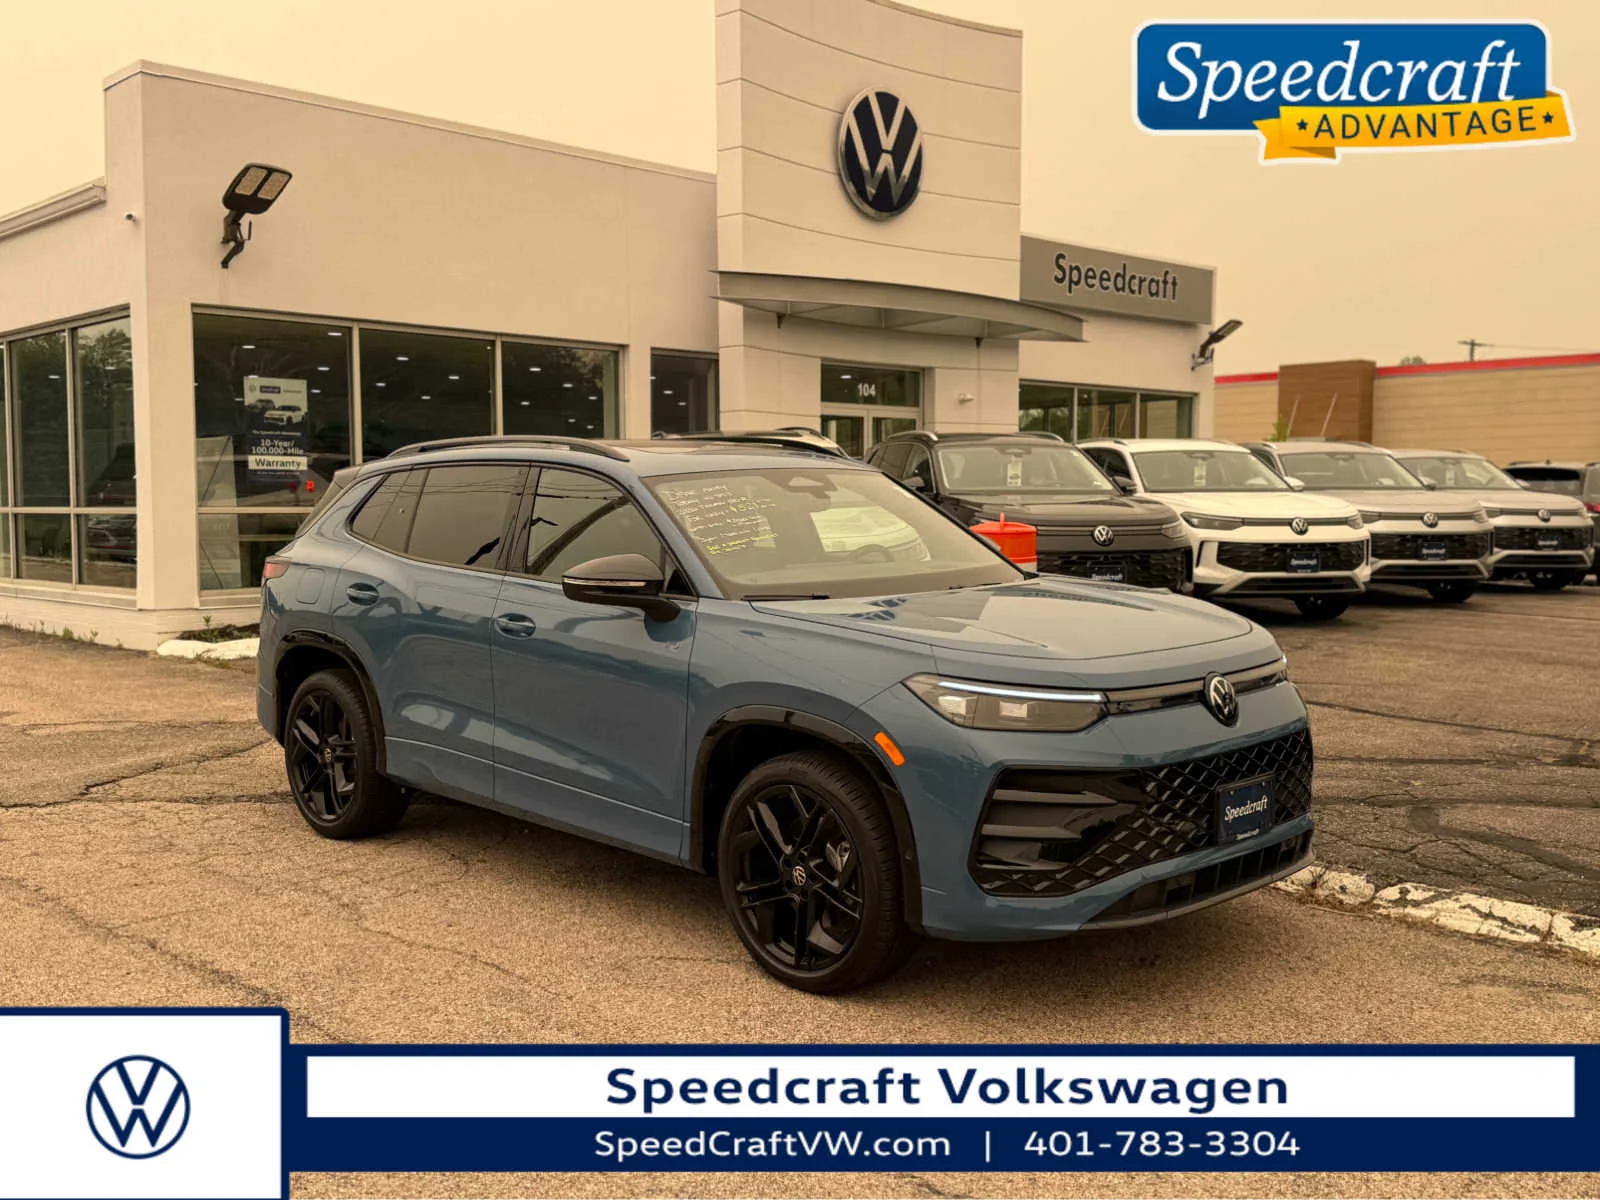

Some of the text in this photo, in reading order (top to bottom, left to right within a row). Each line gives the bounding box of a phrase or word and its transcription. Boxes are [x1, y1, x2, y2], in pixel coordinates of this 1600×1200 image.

[838, 86, 923, 220] VW
[1053, 253, 1178, 300] Speedcraft
[857, 384, 876, 397] 104
[255, 457, 302, 469] Warranty
[1224, 795, 1268, 823] Speedcraft
